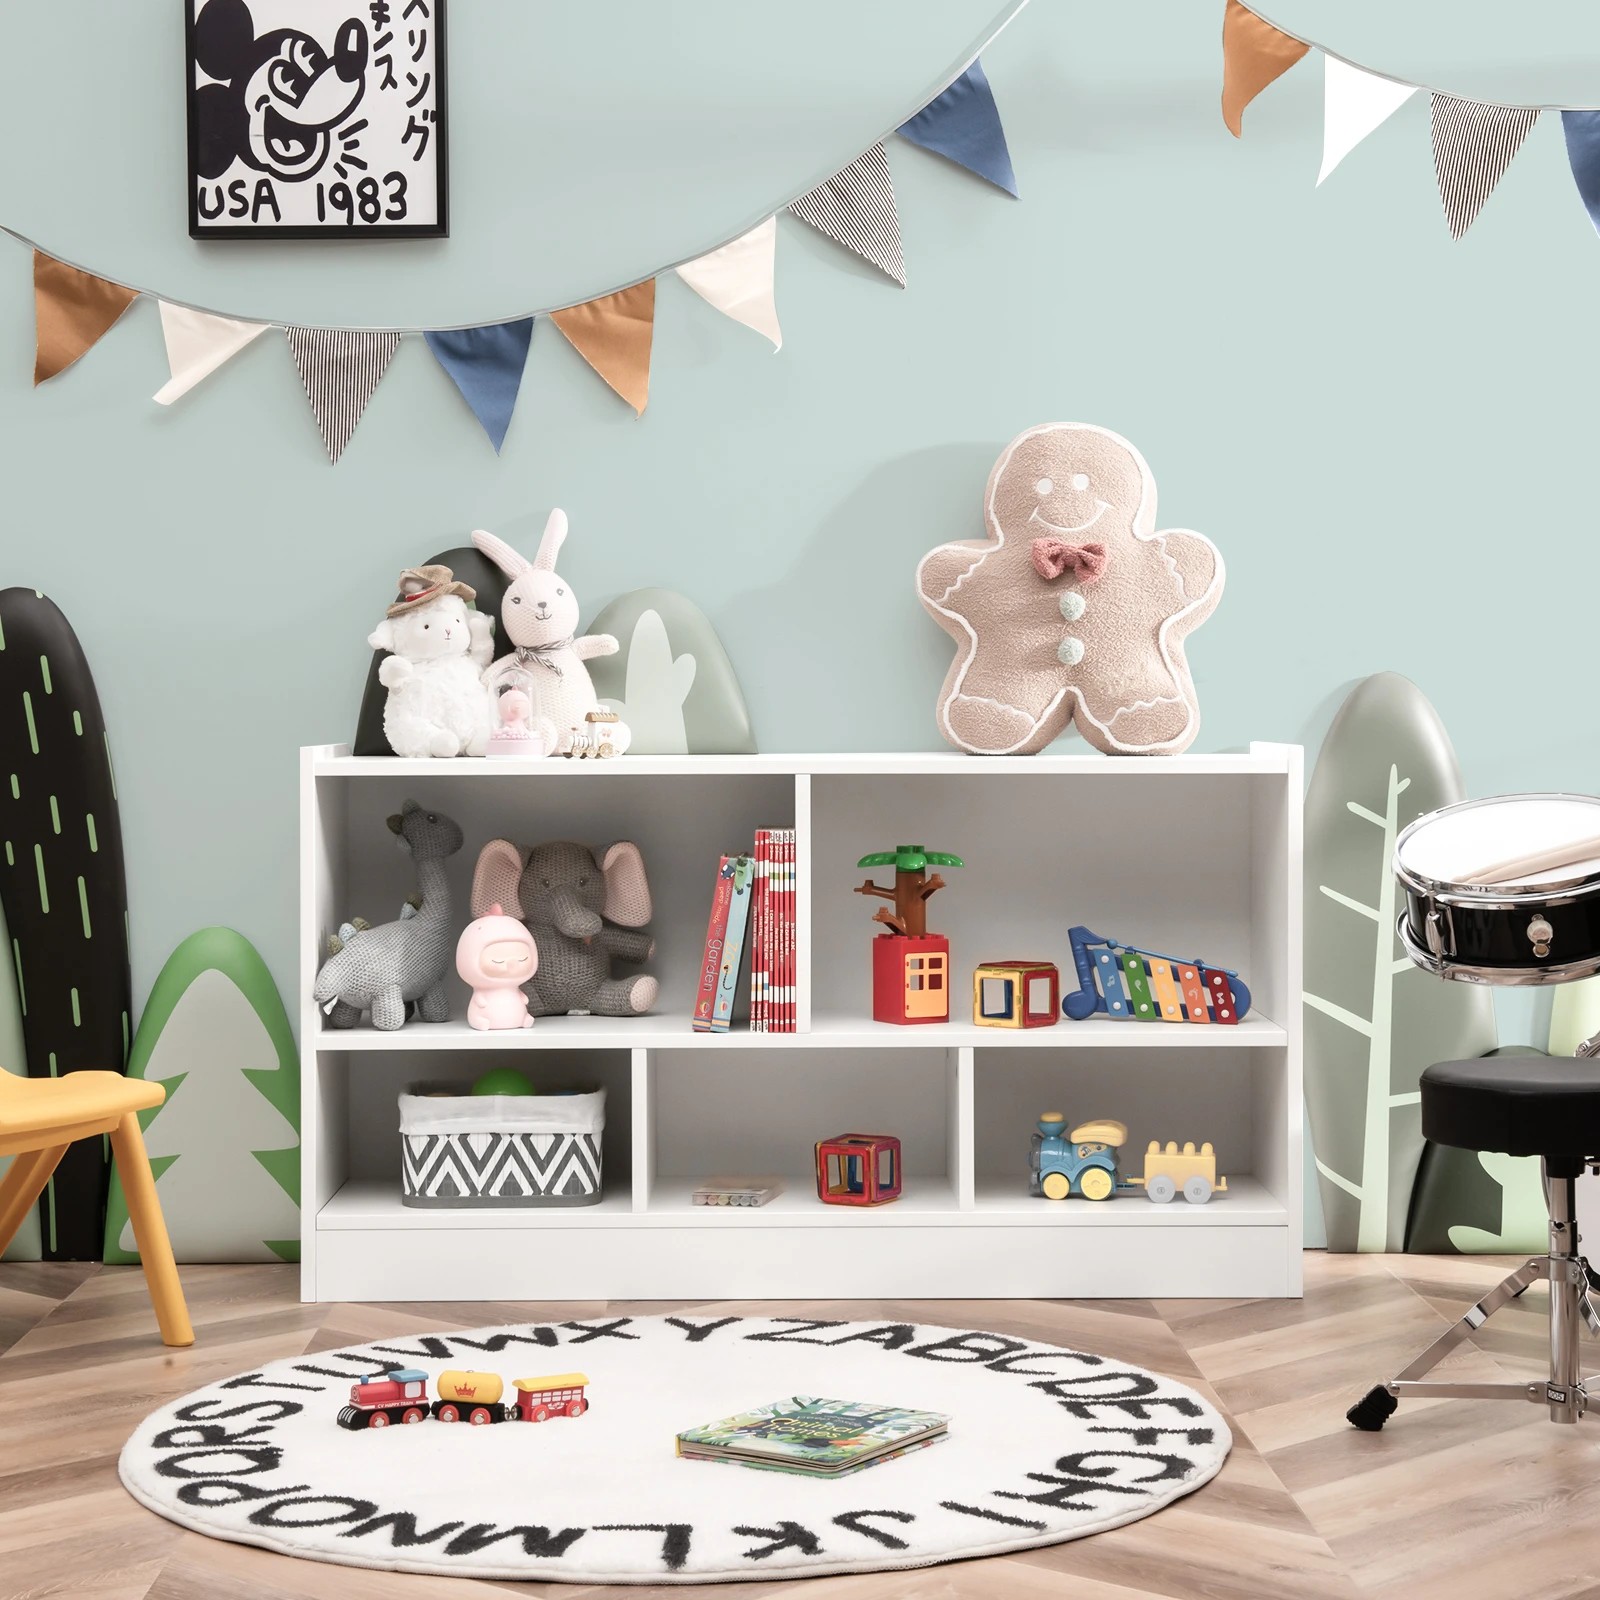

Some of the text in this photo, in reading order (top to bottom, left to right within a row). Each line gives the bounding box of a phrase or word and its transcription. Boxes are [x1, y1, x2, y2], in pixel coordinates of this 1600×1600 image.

[198, 171, 408, 226] USA 1983
[703, 939, 723, 992] garden
